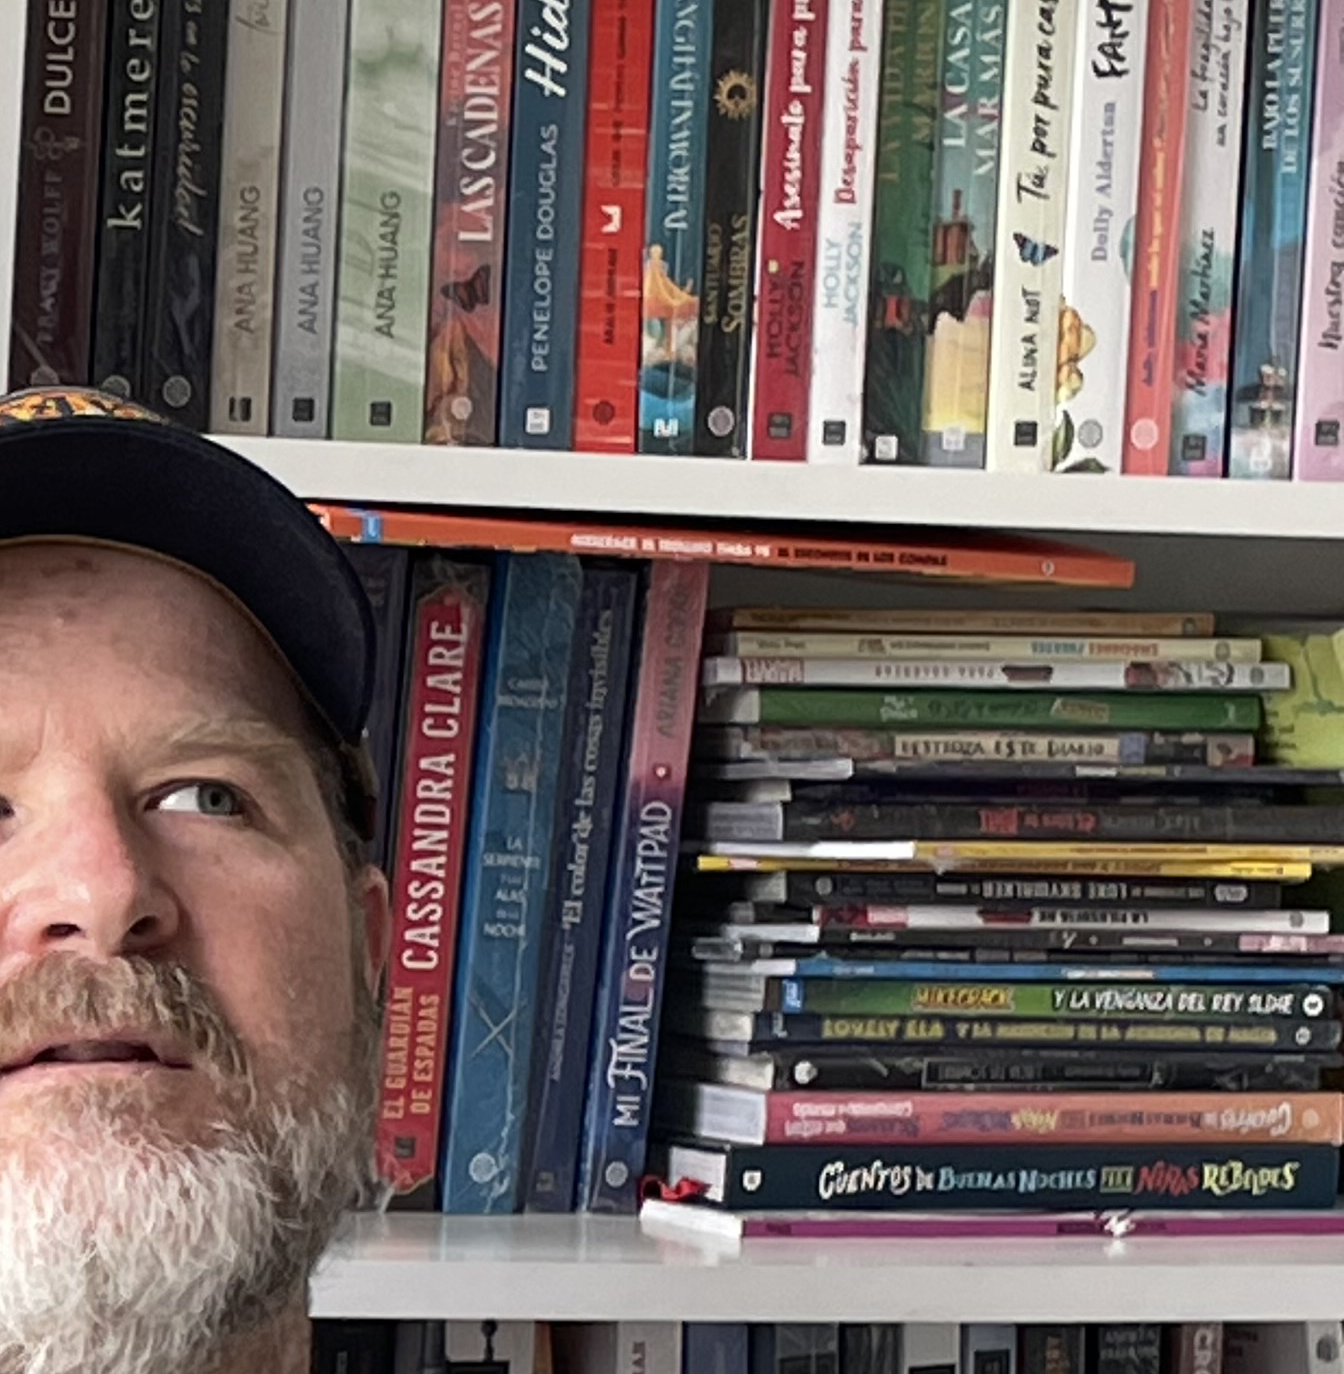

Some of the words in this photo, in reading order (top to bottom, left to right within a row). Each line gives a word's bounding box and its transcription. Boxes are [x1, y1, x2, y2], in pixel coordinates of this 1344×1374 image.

[44, 0, 77, 115] DULCE
[461, 0, 504, 171] CADENAS
[943, 2, 972, 95] CASA
[975, 4, 1003, 83] MÁS
[1031, 43, 1060, 107] pura
[944, 101, 970, 148] LA
[974, 96, 1000, 178] MAR
[1029, 113, 1057, 157] por
[1094, 100, 1116, 198] Alderton
[456, 176, 496, 243] LAS
[535, 124, 559, 240] DOUGLAS
[1016, 167, 1050, 204] Tú
[235, 185, 260, 275] HUANG
[378, 191, 401, 281] HUANG
[1090, 204, 1114, 262] Dolly
[235, 281, 256, 335] ANA
[375, 287, 397, 339] ANA
[530, 248, 553, 372] PENELOPE
[419, 620, 466, 739] CLARE
[401, 752, 456, 972] CASSANDRA
[626, 801, 673, 941] WATTPAD
[627, 946, 659, 982] DE
[384, 985, 414, 1091] GUARDIÁN
[412, 993, 439, 1084] ESPADAS
[608, 988, 655, 1090] FINAL
[382, 1095, 406, 1120] EL
[409, 1090, 432, 1115] DE
[612, 1095, 641, 1127] MI
